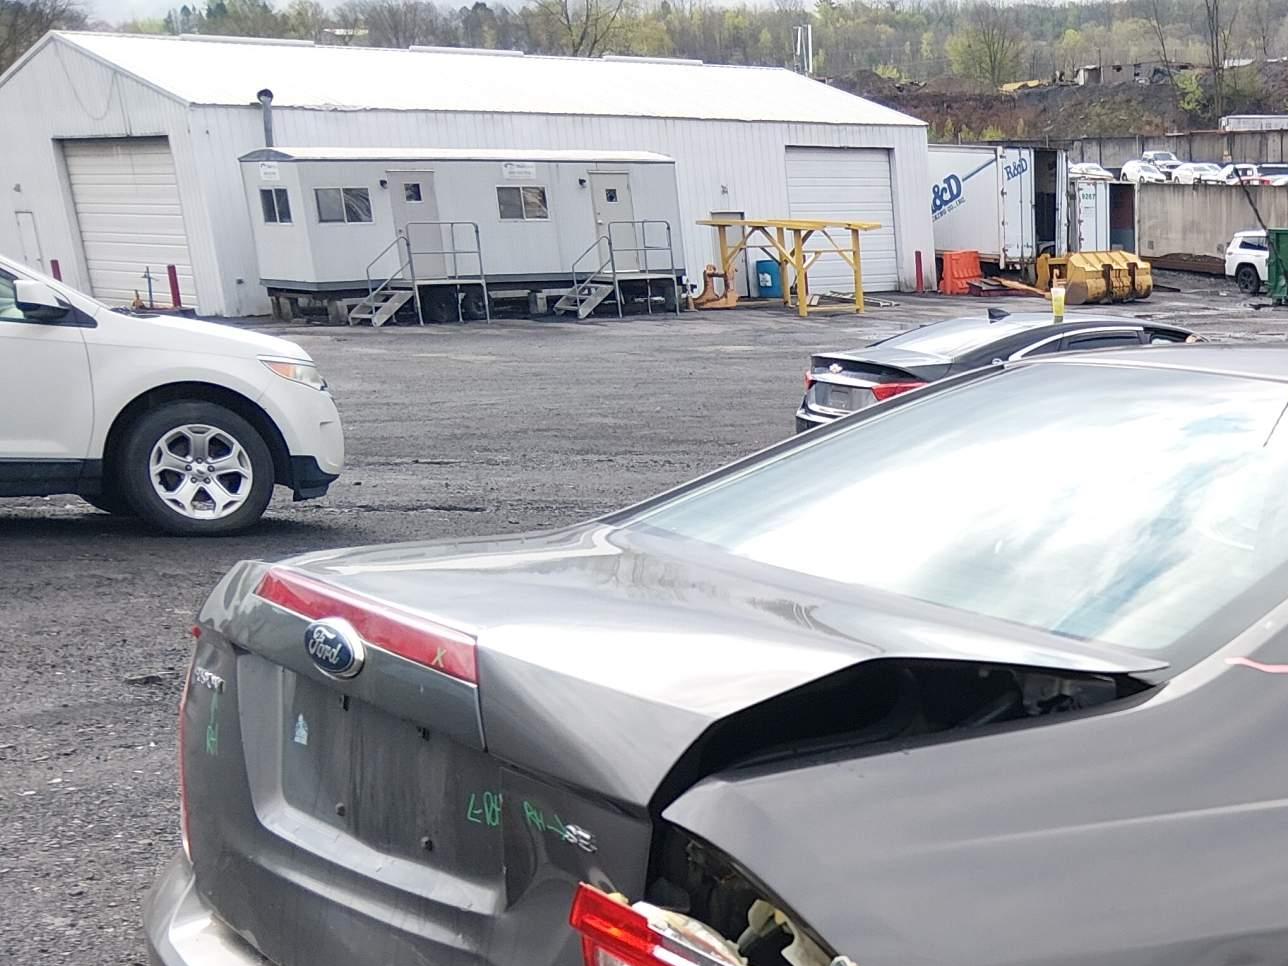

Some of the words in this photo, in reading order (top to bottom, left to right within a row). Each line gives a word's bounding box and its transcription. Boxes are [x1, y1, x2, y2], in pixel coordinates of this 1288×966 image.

[1004, 157, 1028, 181] R&D
[931, 174, 962, 215] &D
[309, 626, 341, 665] Ford
[565, 825, 598, 853] SE
